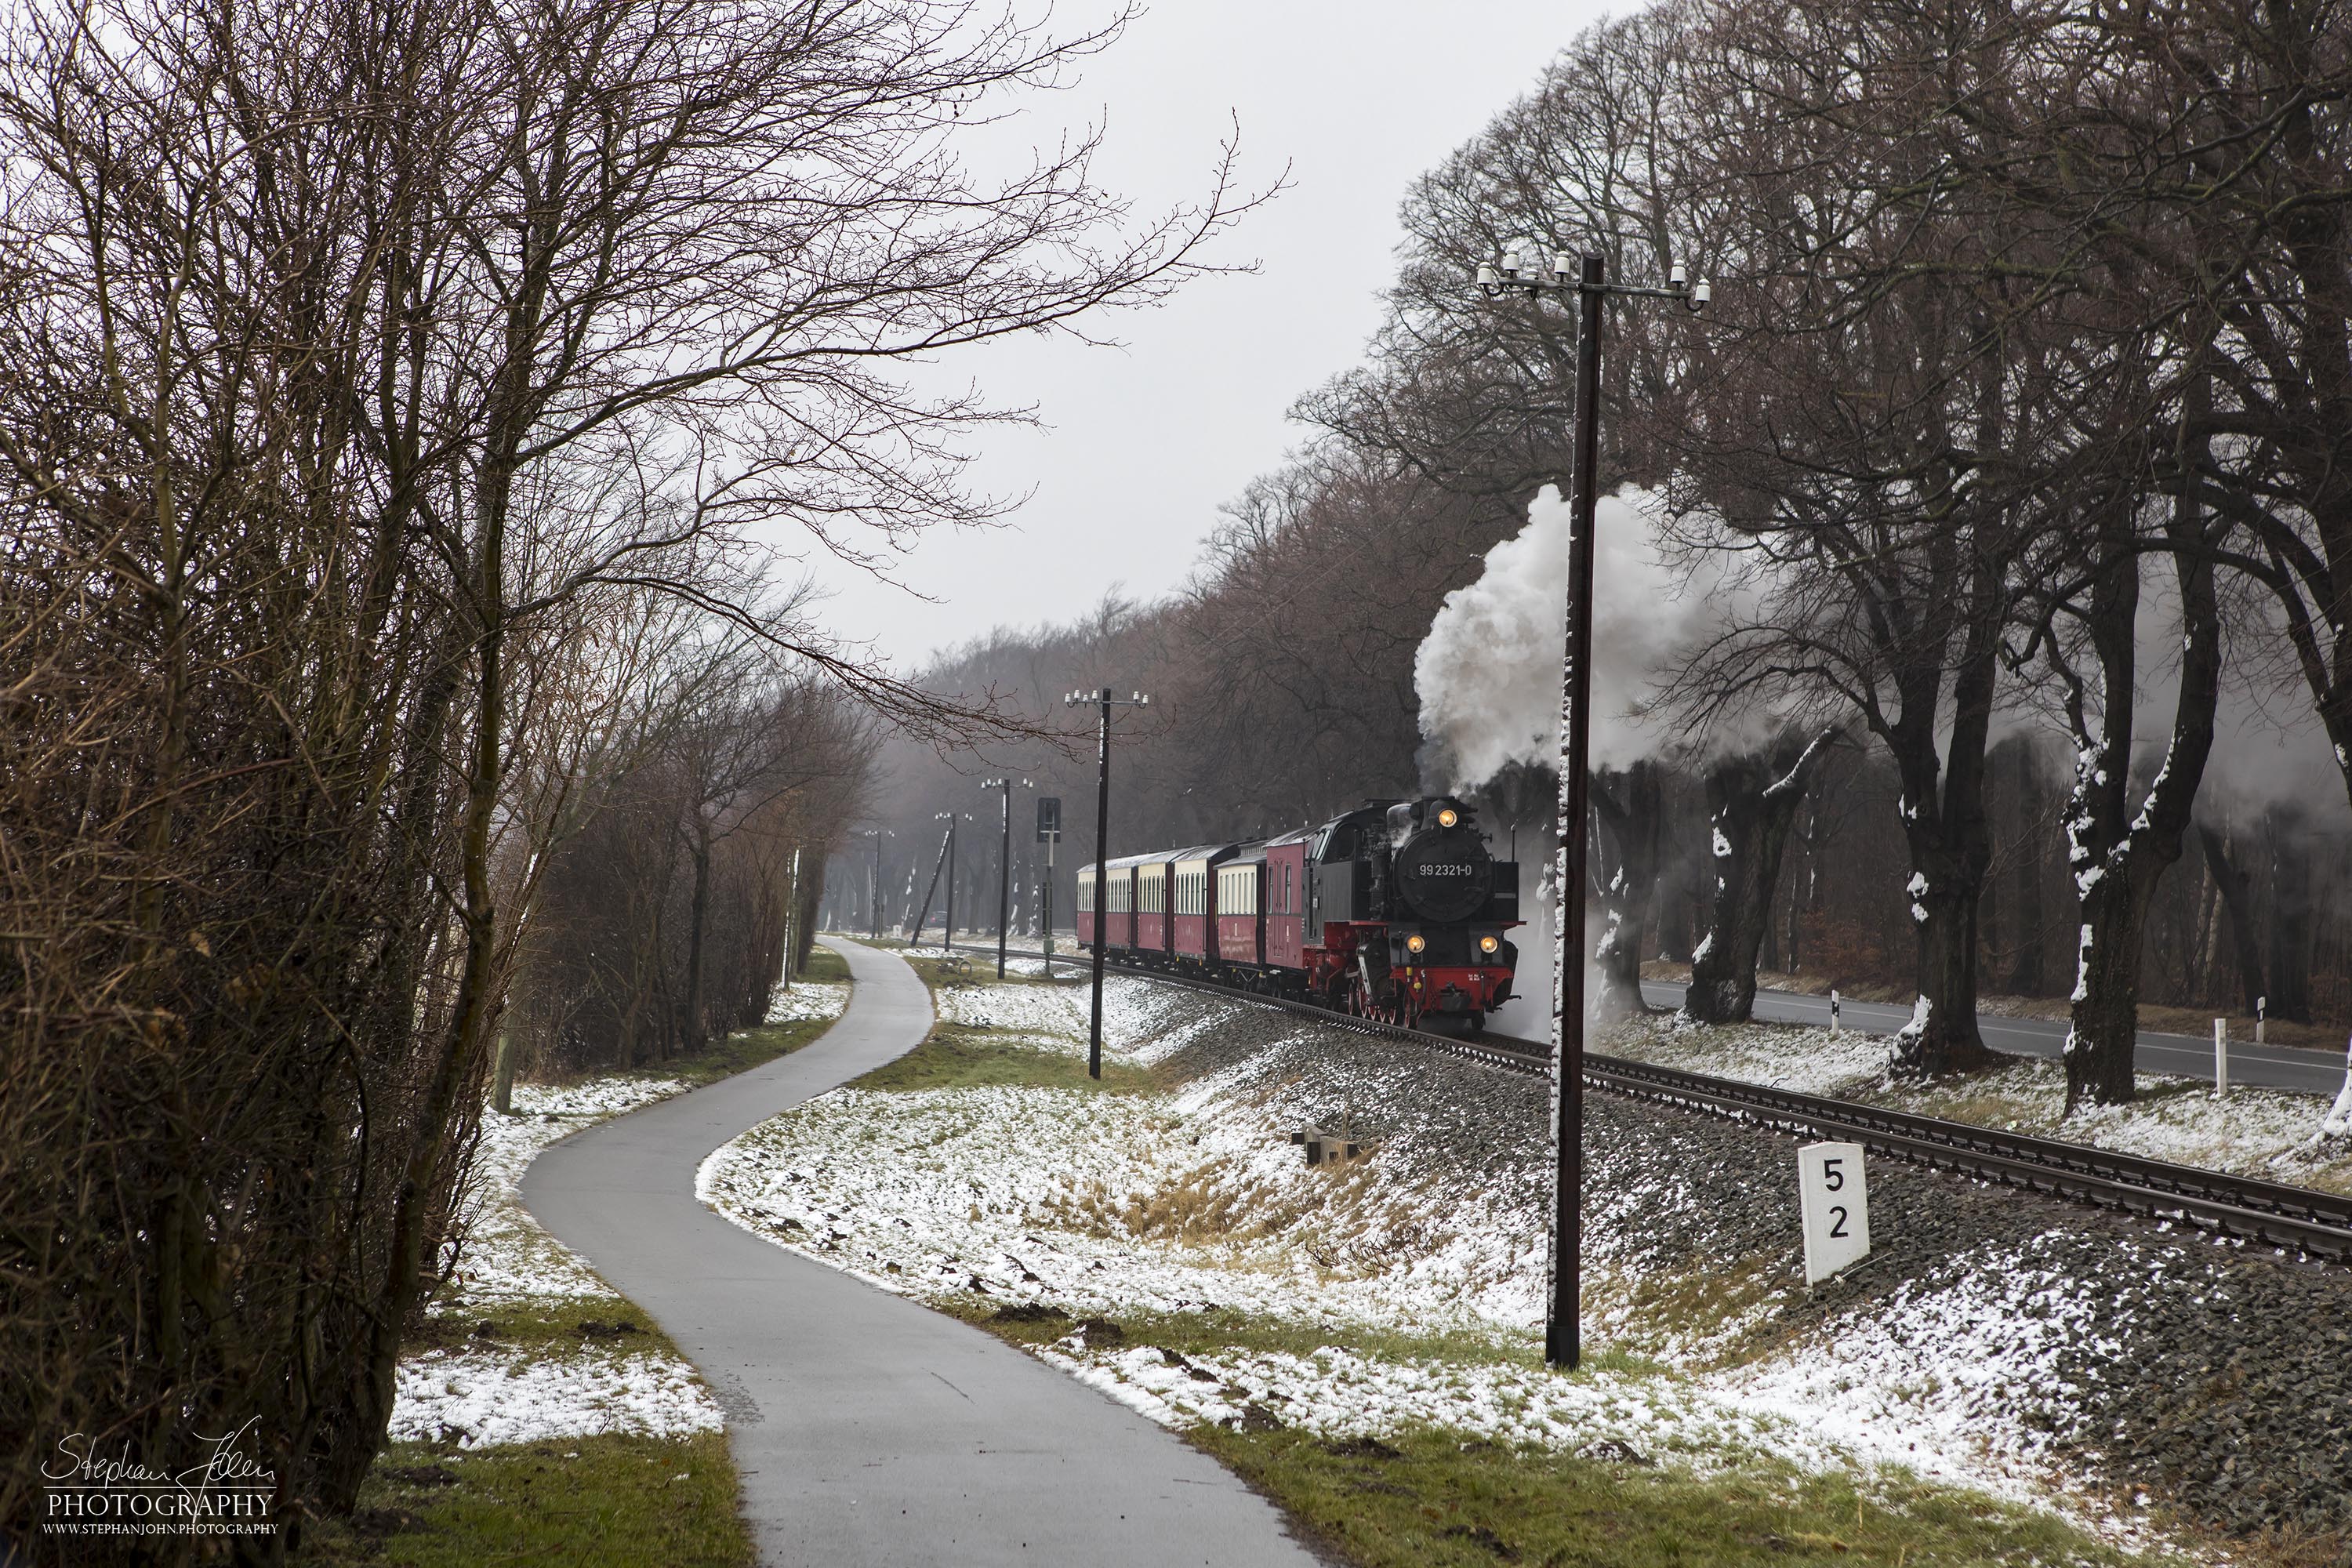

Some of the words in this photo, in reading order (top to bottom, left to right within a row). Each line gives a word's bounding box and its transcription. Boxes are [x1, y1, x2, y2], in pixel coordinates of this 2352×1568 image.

[1420, 865, 1433, 876] 99
[1435, 865, 1472, 876] 2321-0
[1824, 1159, 1844, 1192] 5
[1829, 1206, 1849, 1238] 2
